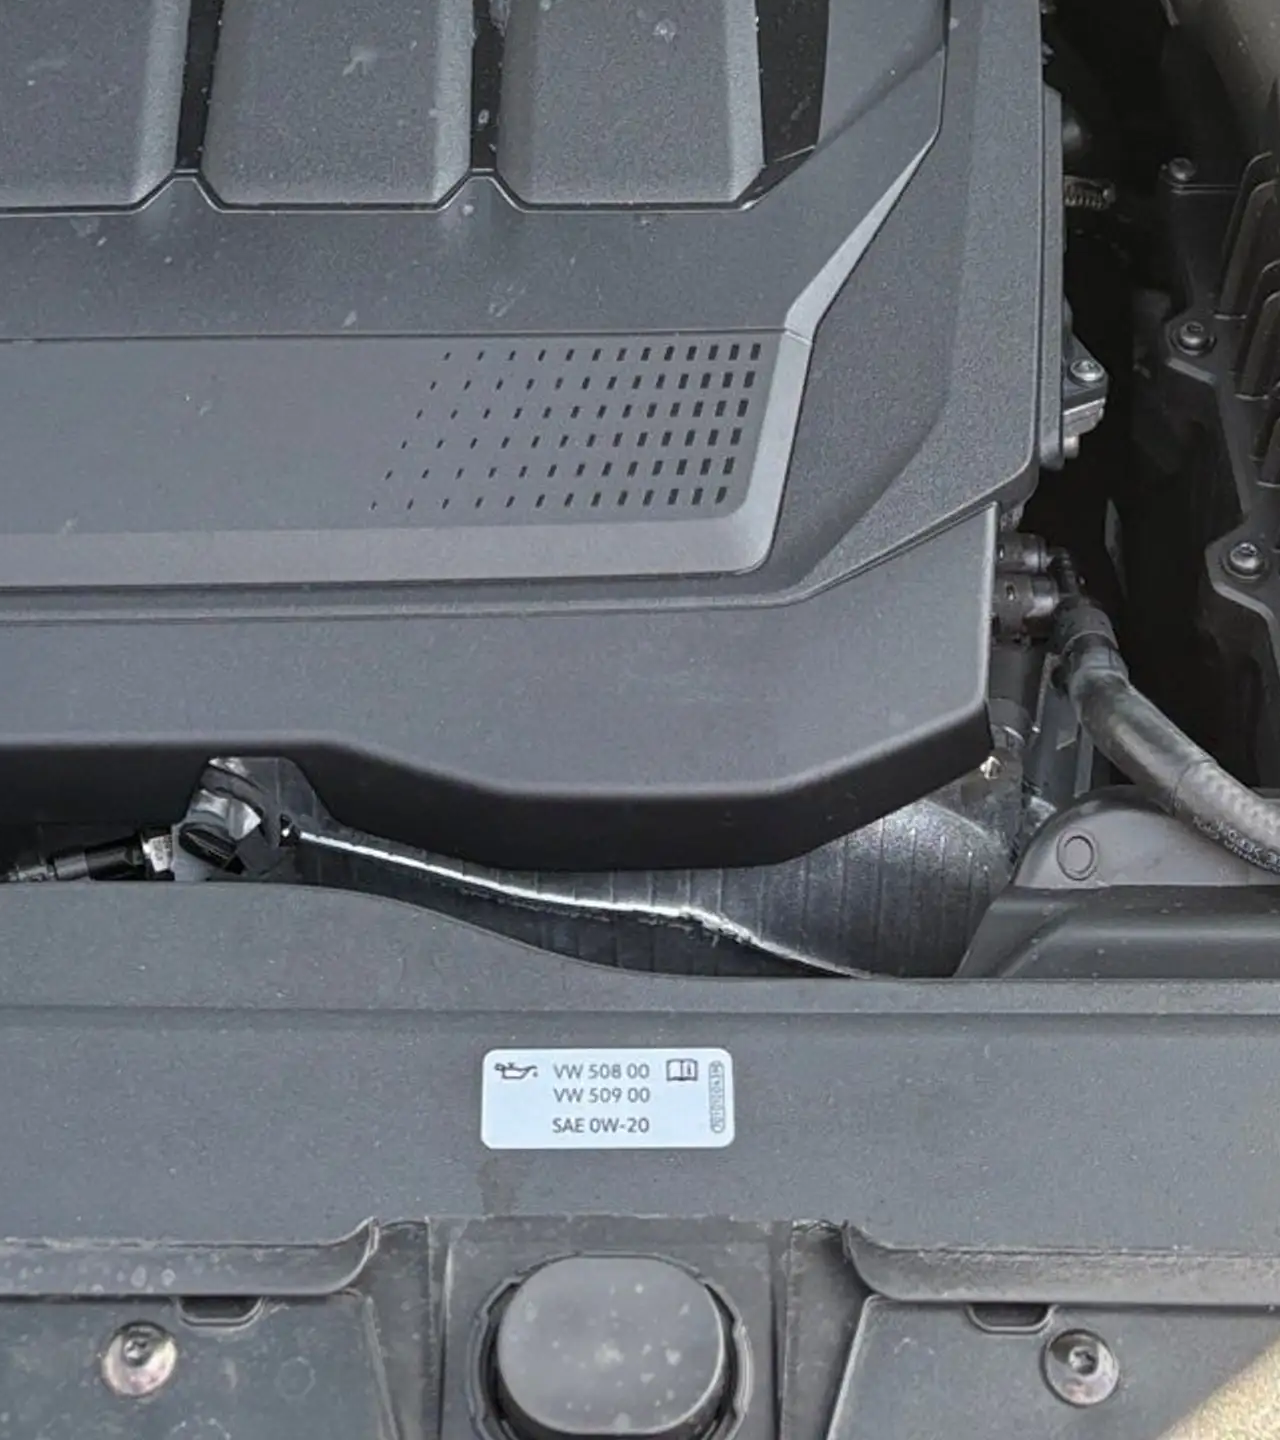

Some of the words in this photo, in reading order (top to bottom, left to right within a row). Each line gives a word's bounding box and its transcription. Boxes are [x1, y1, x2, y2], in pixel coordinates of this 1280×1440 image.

[553, 1063, 584, 1079] VW
[589, 1063, 622, 1079] 508
[627, 1063, 650, 1079] 00
[553, 1088, 584, 1103] VW
[589, 1088, 622, 1103] 509
[627, 1087, 650, 1103] 00
[552, 1117, 584, 1133] SAE
[590, 1117, 650, 1133] 0W-20
